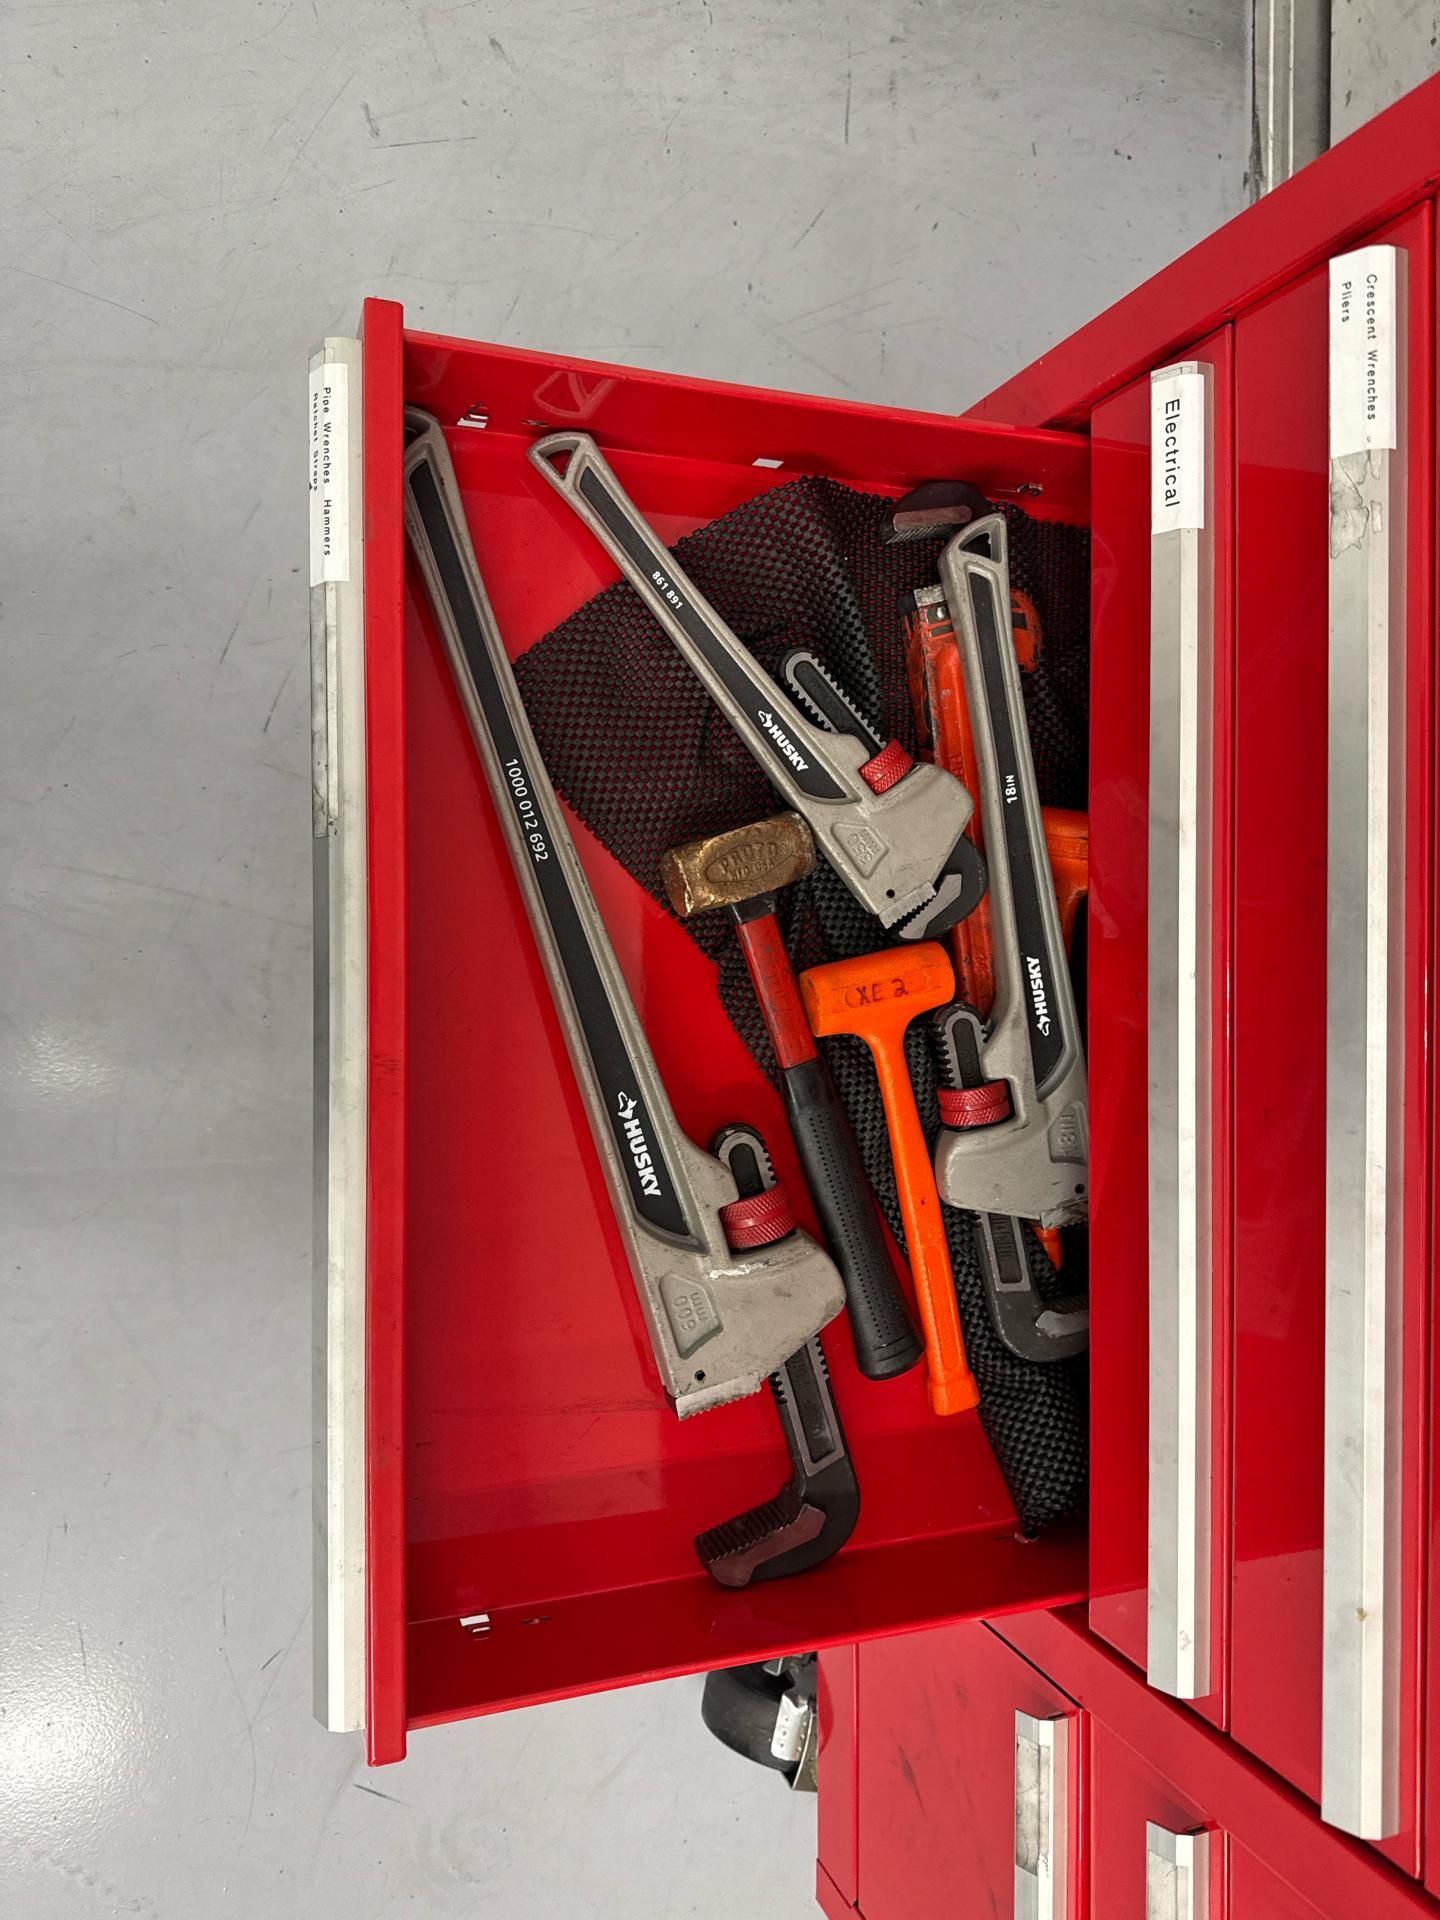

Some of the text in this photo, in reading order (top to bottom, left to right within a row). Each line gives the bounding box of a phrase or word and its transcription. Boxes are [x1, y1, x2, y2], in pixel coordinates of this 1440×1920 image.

[1341, 281, 1352, 323] Pliers
[1366, 274, 1378, 420] Crescent Wrenches
[323, 387, 332, 556] Pipe Wrenches Hammers
[1165, 398, 1180, 507] Electrical
[652, 571, 683, 609] 861 891
[768, 724, 809, 772] HUSKY
[505, 758, 549, 863] 1000 012 692
[1026, 956, 1048, 1015] HUSKY
[623, 1118, 661, 1196] HUSKY
